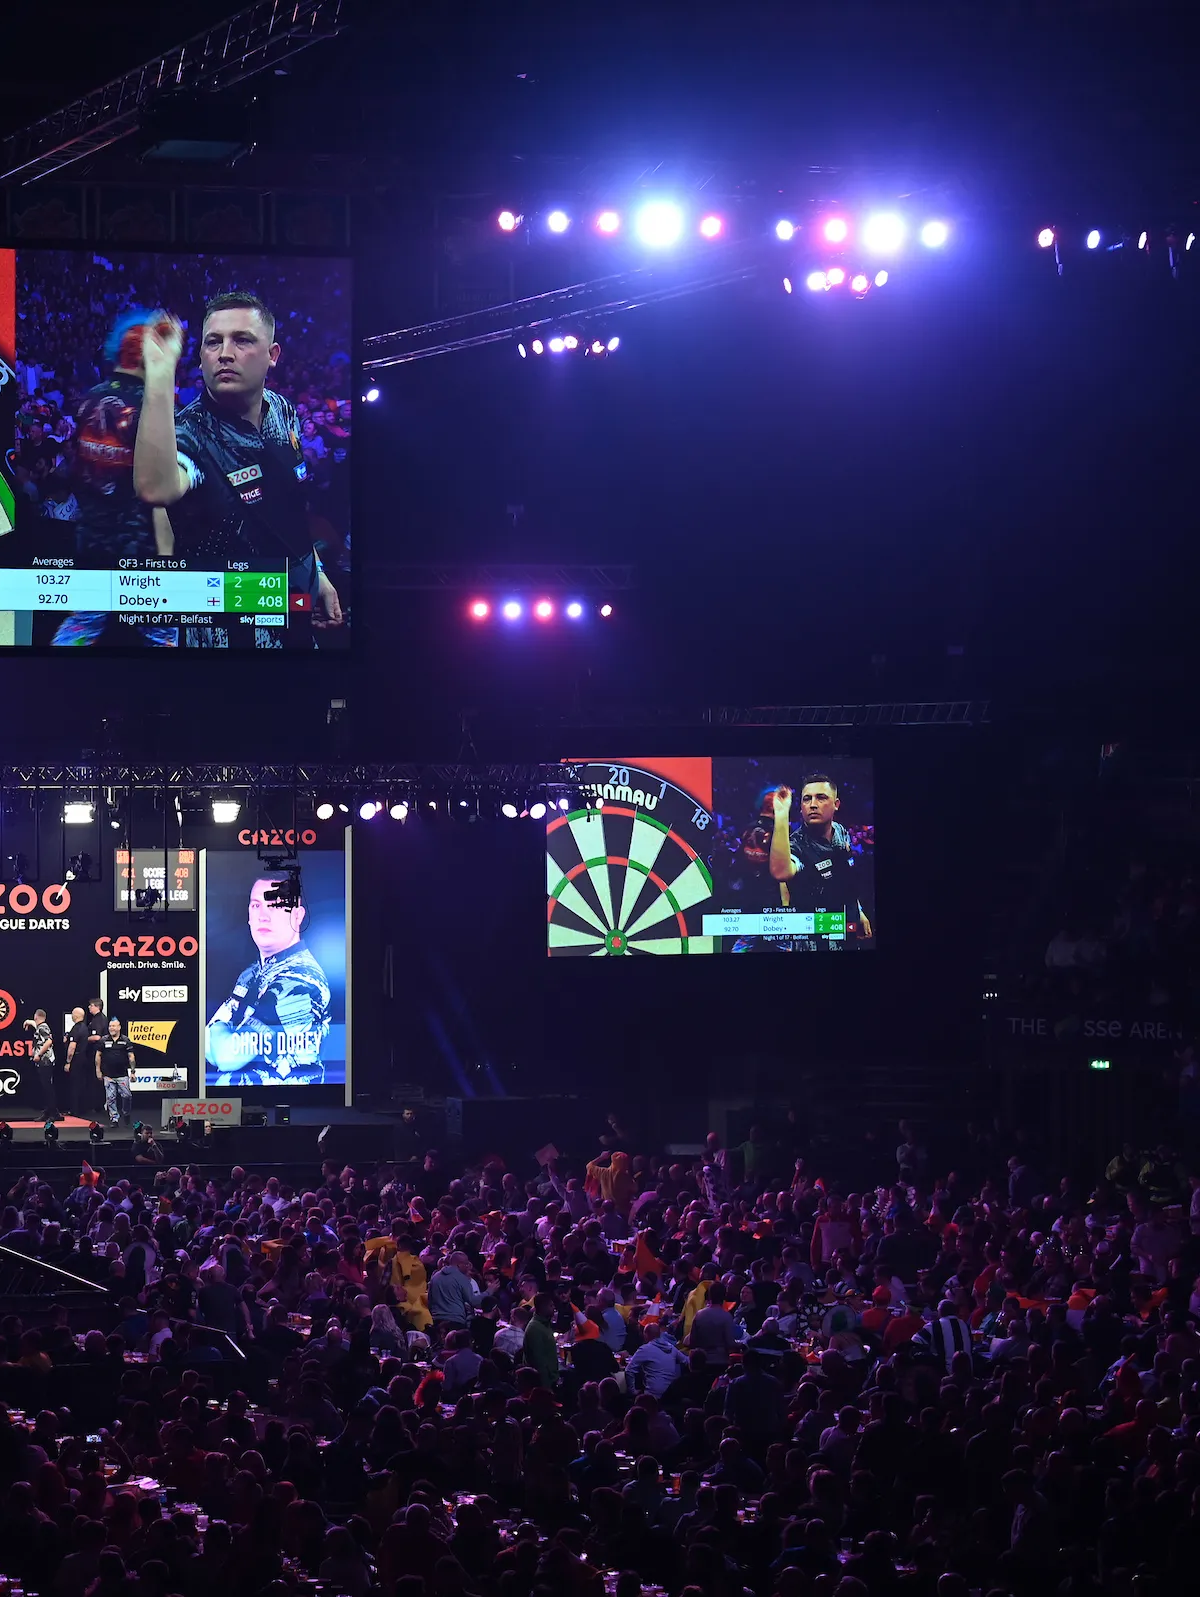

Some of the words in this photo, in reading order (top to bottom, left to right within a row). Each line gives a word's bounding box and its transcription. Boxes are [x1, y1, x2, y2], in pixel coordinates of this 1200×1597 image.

[32, 557, 74, 568] Averages
[119, 559, 137, 569] QF3
[146, 559, 164, 569] First
[165, 560, 177, 569] to
[180, 560, 186, 569] 6
[227, 560, 249, 570] Legs
[36, 575, 70, 585] 103.27
[119, 575, 161, 588] Wright
[234, 577, 242, 587] 2
[258, 577, 281, 588] 401
[38, 594, 68, 604] 92.70
[119, 594, 159, 608] Dobey
[234, 596, 242, 607] 2
[258, 596, 283, 607] 408
[119, 614, 144, 625] Night
[151, 614, 162, 624] of
[164, 615, 173, 624] 17
[181, 614, 213, 624] Belfast
[240, 616, 254, 625] sky
[256, 616, 283, 625] sports
[608, 767, 630, 786] 20
[659, 782, 666, 799] 1
[690, 807, 710, 831] 18
[238, 829, 317, 845] CAZOO
[143, 867, 166, 878] SCORE
[174, 868, 189, 878] 408
[176, 879, 182, 889] 2
[170, 890, 189, 901] LEGS
[28, 918, 70, 930] DARTS
[95, 936, 198, 957] CAZOO
[107, 961, 137, 969] Search.
[138, 961, 160, 969] Drive.
[162, 960, 186, 969] Smile.
[119, 987, 141, 1002] sky
[145, 987, 185, 1002] sports
[130, 1022, 154, 1033] inter
[1006, 1017, 1047, 1035] THE
[133, 1032, 167, 1042] wetten
[232, 1031, 272, 1055] CHRIS
[277, 1031, 322, 1055] DOBEY
[172, 1103, 232, 1115] CAZOO
